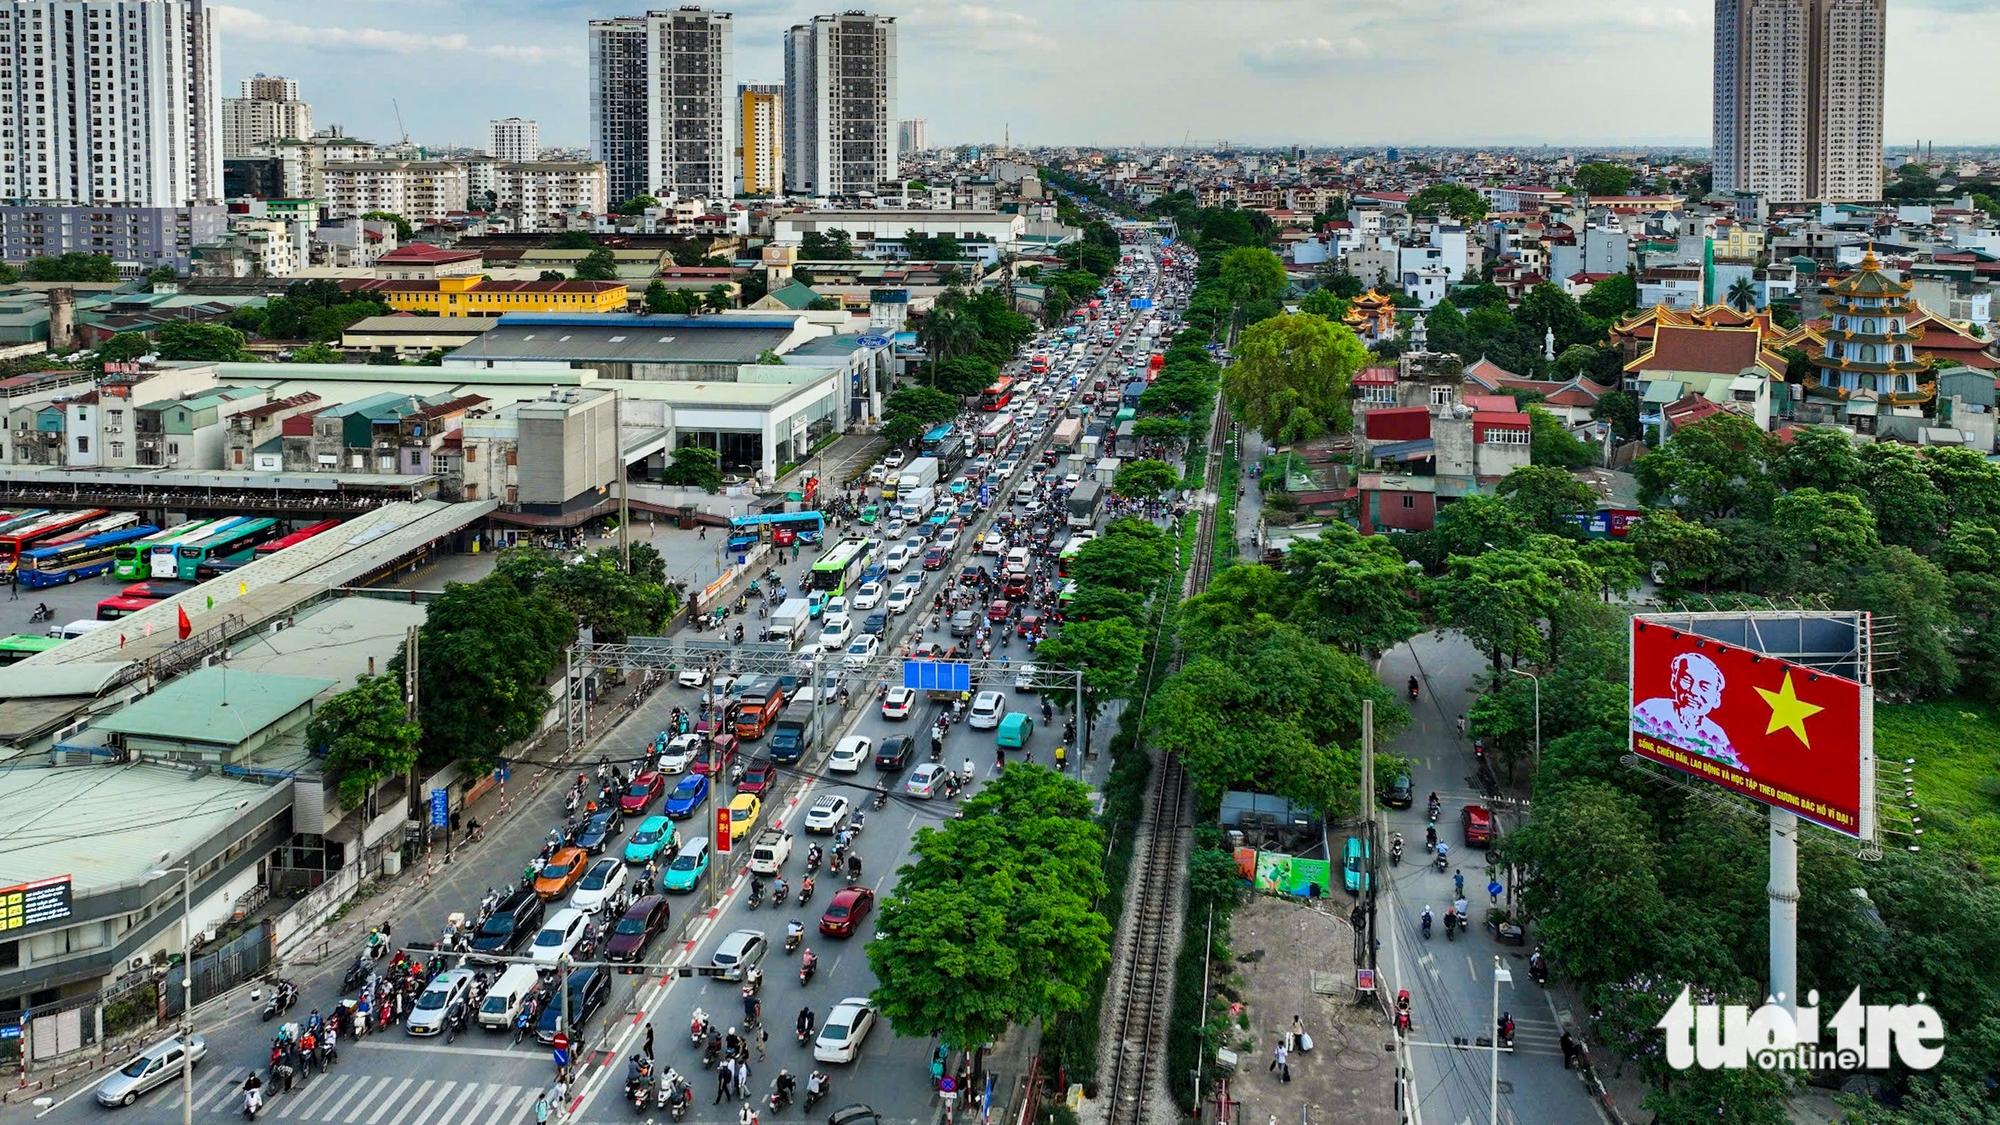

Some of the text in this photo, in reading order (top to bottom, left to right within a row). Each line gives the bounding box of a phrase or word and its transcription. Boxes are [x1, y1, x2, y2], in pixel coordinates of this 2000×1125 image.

[861, 336, 882, 346] Ford
[1638, 738, 1656, 753] SỐNG,
[1657, 745, 1674, 759] CHIẾN
[1676, 752, 1689, 766] ĐẤU,
[1690, 758, 1702, 769] LAO
[1703, 763, 1721, 777] ĐỘNG
[1721, 768, 1730, 780] VÀ
[1731, 774, 1744, 786] HỌC
[1745, 778, 1757, 791] TẬP
[1759, 783, 1775, 797] THEO
[1801, 799, 1815, 812] BÁC
[1827, 808, 1835, 819] VĨ
[1836, 813, 1849, 825] ĐẠI
